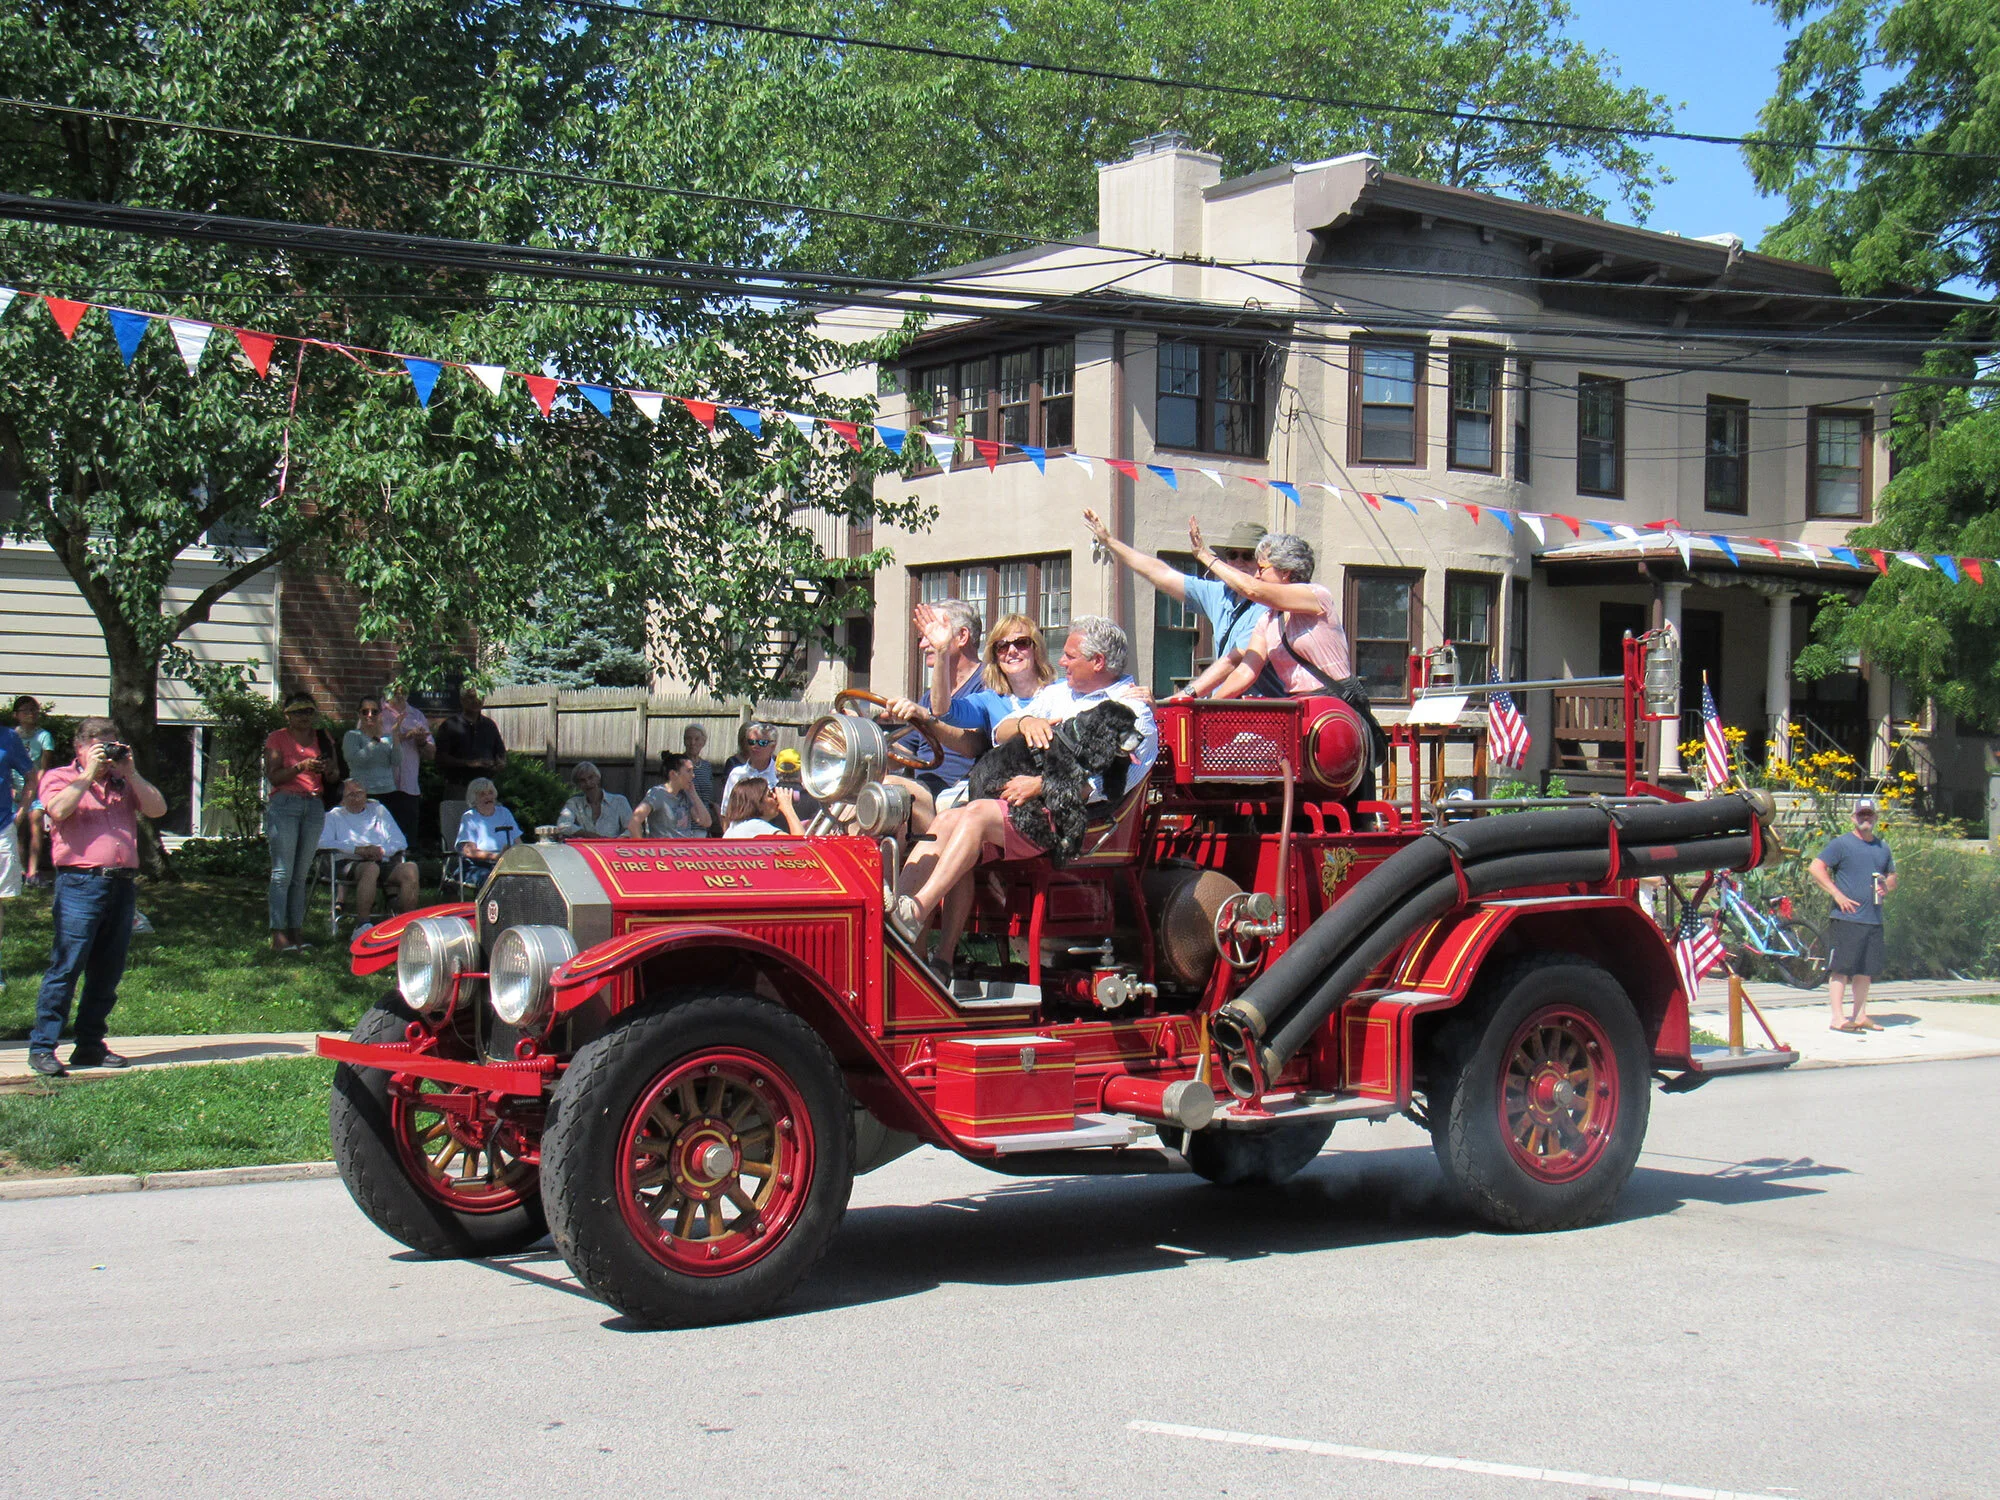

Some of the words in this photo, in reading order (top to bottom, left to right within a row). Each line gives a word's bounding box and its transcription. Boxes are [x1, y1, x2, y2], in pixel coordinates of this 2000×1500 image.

[614, 847, 795, 857] SWARTHMORE
[611, 861, 652, 872] FIRE
[655, 860, 671, 871] &
[672, 860, 768, 871] PROTECTIVE
